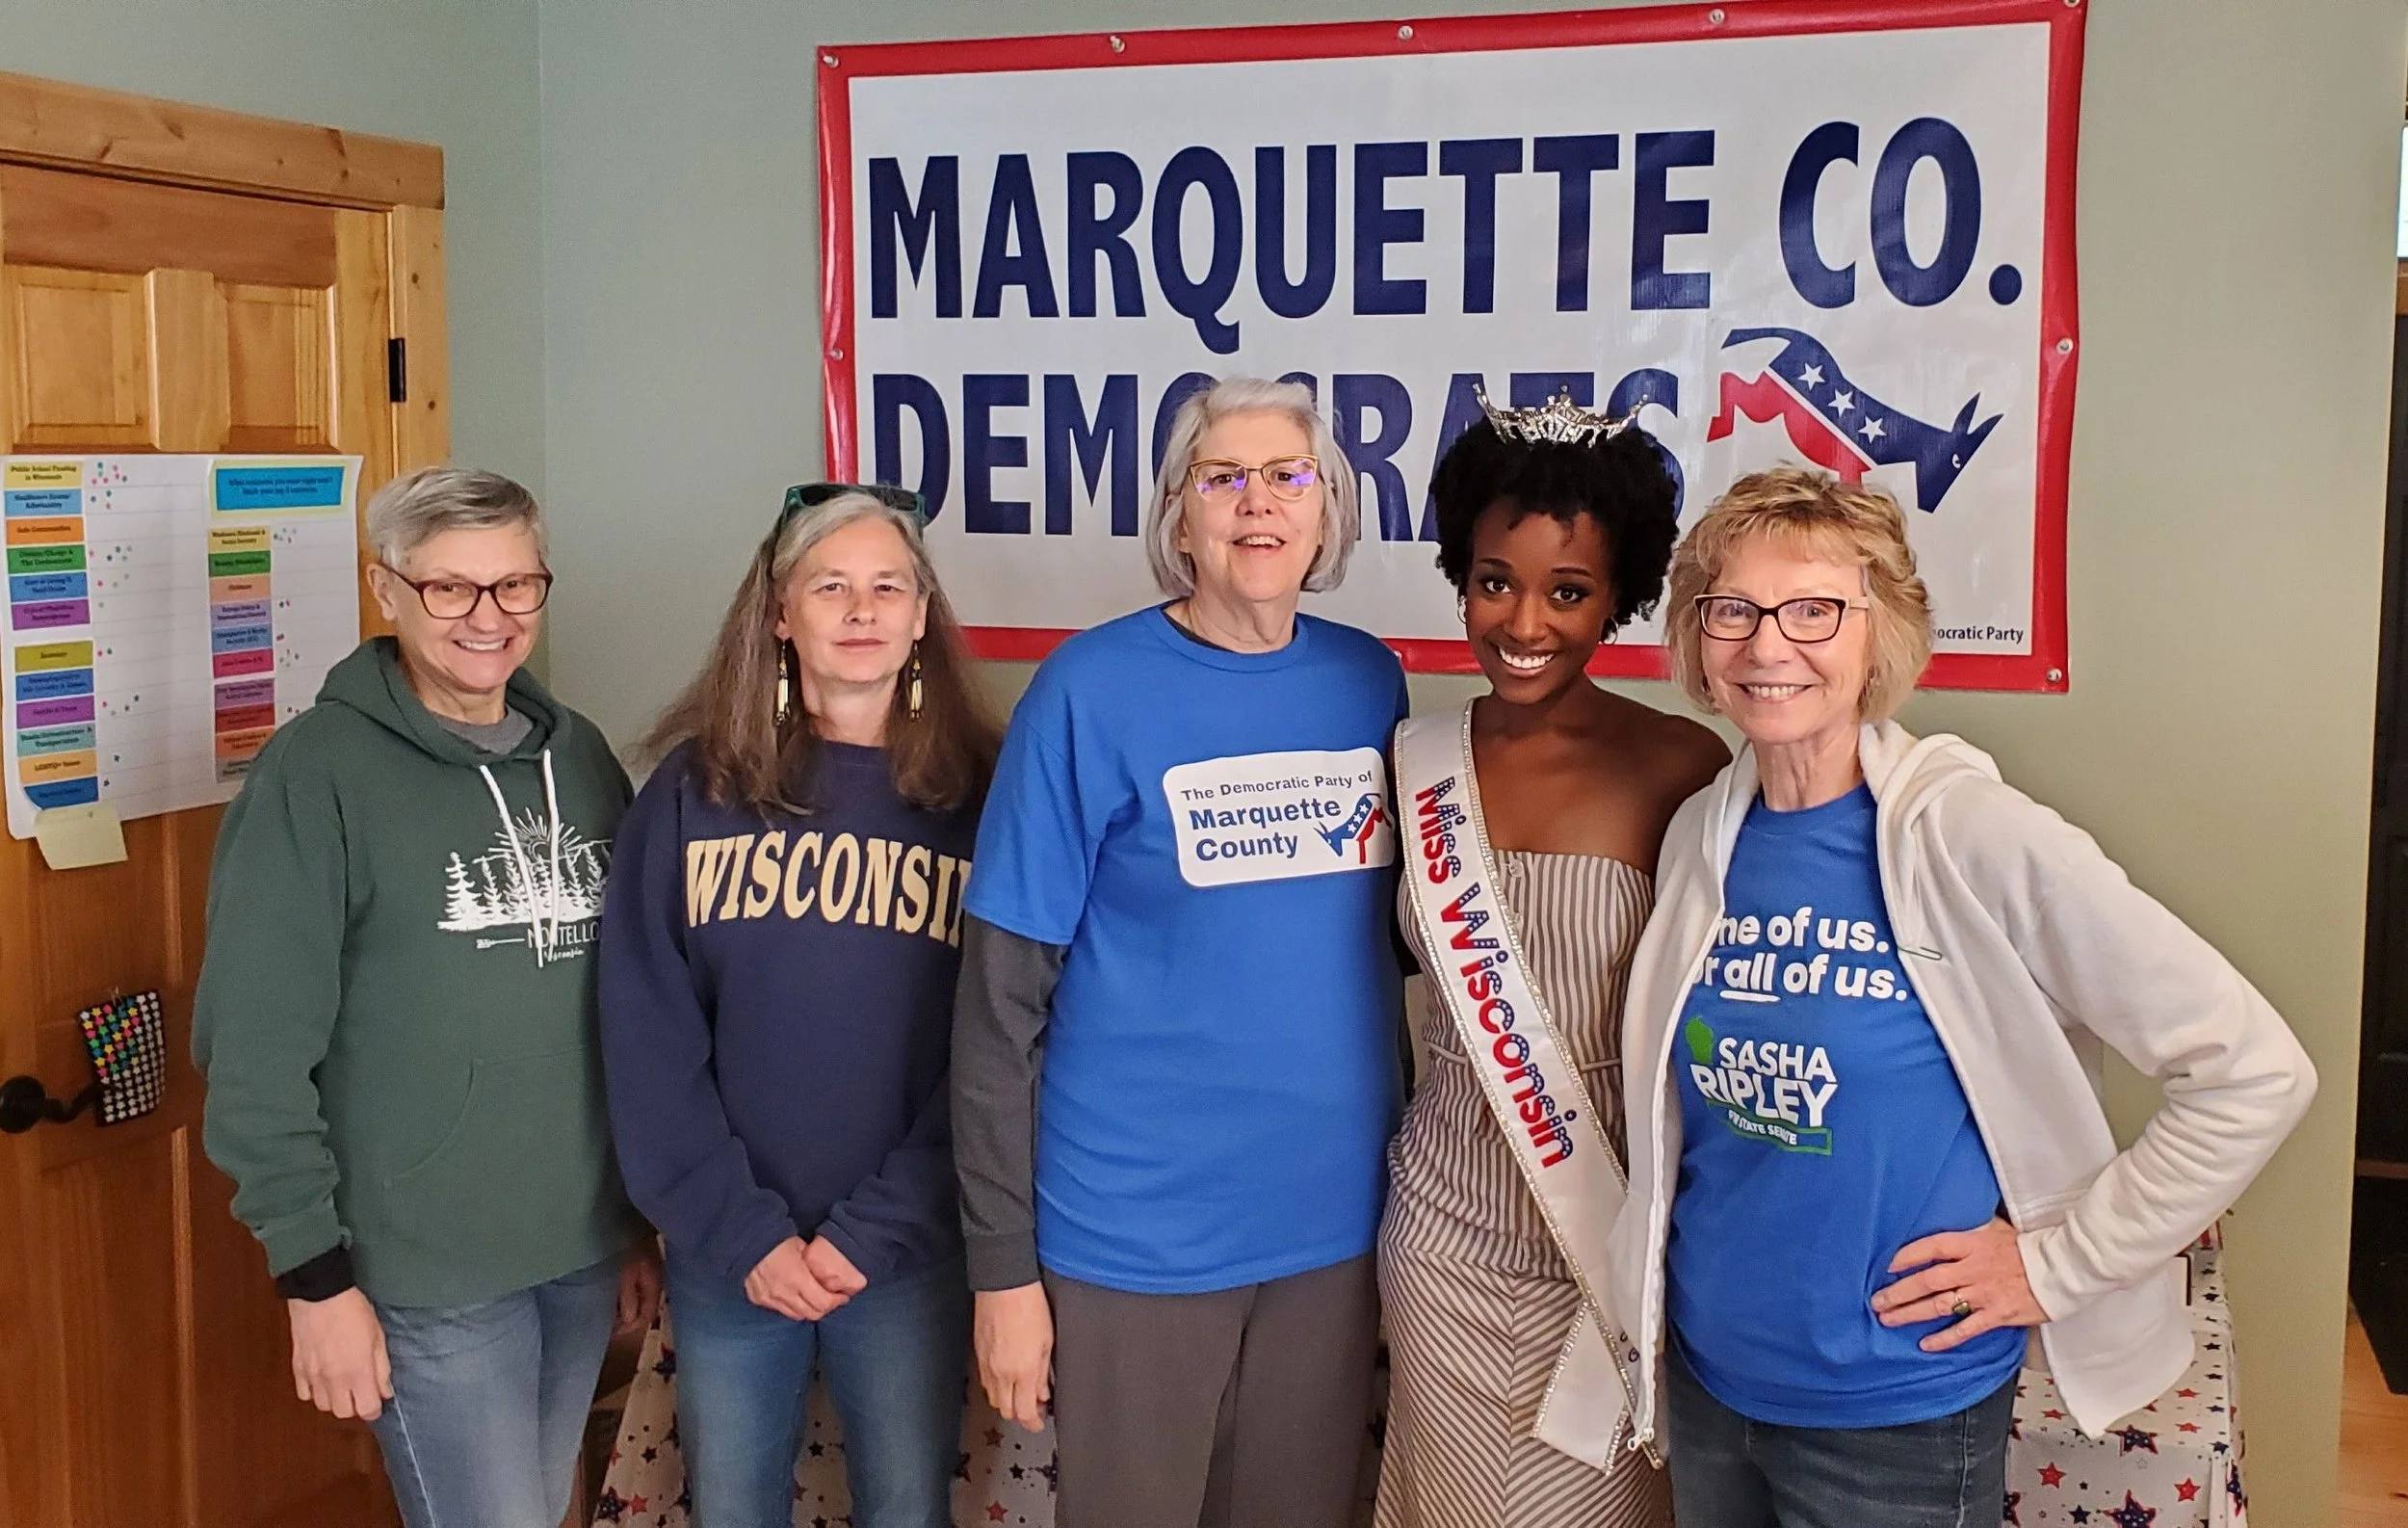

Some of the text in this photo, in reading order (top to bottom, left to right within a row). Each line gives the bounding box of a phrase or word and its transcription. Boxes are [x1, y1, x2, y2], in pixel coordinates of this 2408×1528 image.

[869, 117, 2023, 354] MARQUETTE CO.
[1937, 625, 2024, 645] ocratic Party
[1180, 770, 1373, 802] The Democratic Party of
[1189, 798, 1342, 830] Marquette
[1195, 831, 1298, 861] County
[1717, 906, 1890, 954] ne of us.
[1414, 776, 1578, 1170] Miss Wisconsin
[1723, 952, 1777, 991] all
[1783, 953, 1830, 994] of
[1834, 965, 1908, 1001] us.
[1717, 1037, 1837, 1083] SASHA
[1689, 1063, 1838, 1128] RIPLEY
